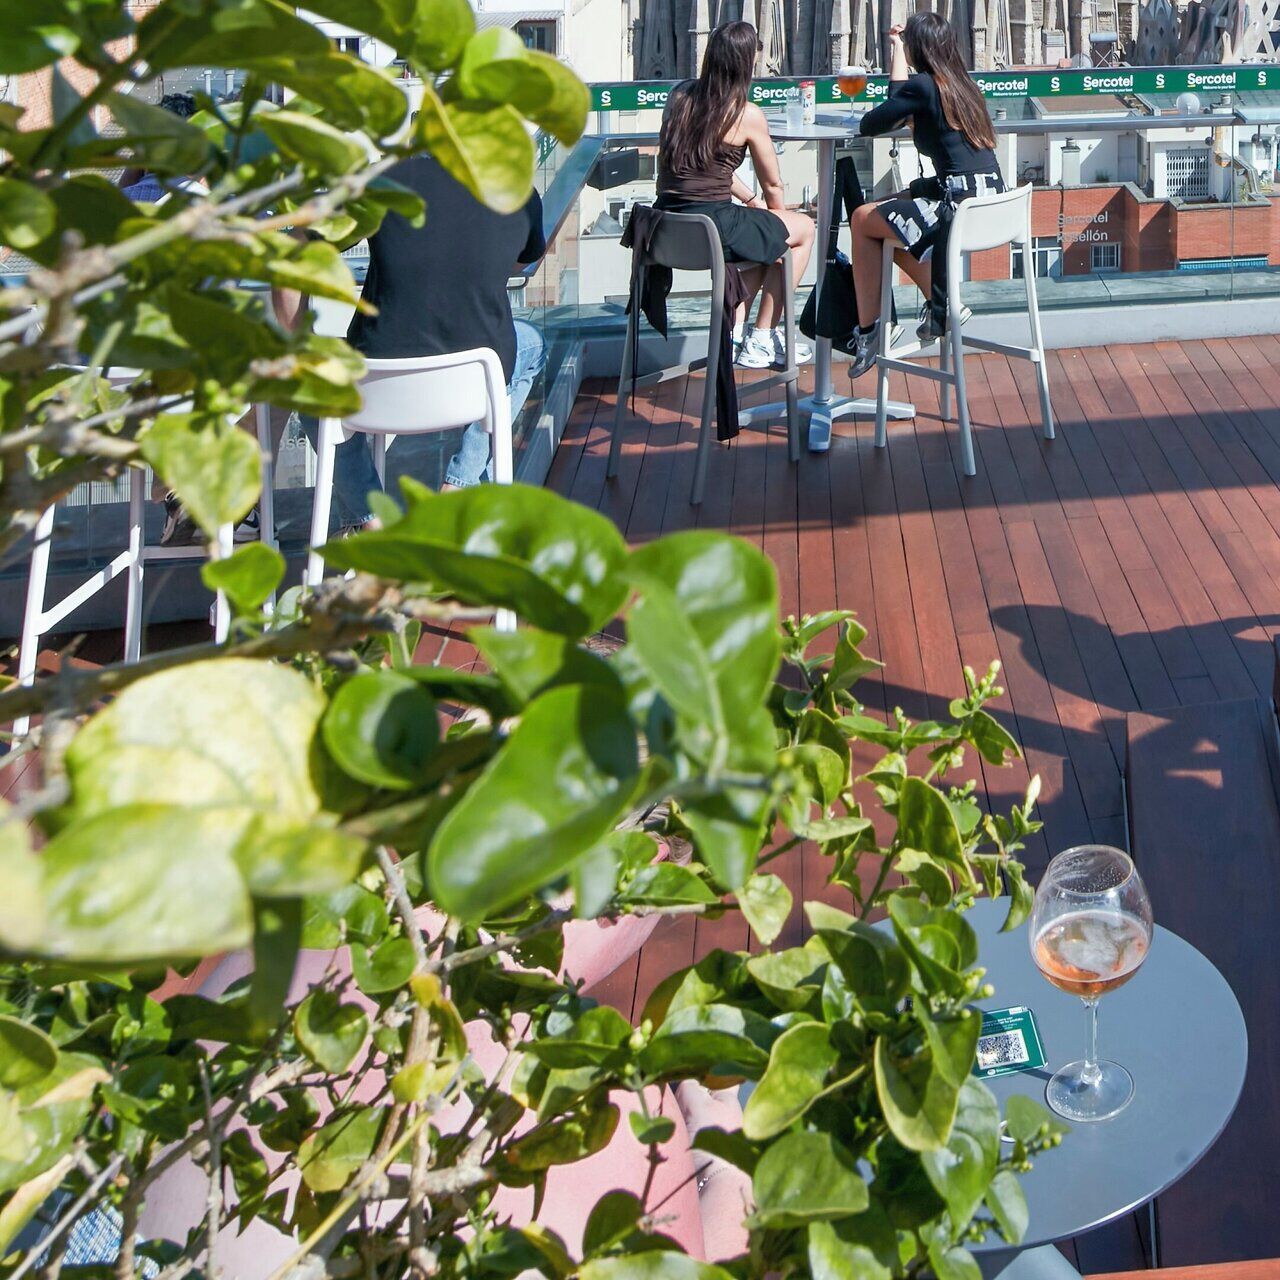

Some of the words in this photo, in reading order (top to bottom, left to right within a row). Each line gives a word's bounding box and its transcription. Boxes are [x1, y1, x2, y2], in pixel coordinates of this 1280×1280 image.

[1051, 77, 1059, 89] S
[1084, 75, 1133, 88] Sercotel
[1156, 74, 1164, 86] S
[1188, 72, 1235, 85] Sercotel
[1258, 71, 1266, 84] S
[977, 78, 1027, 91] Sercotel
[602, 91, 611, 103] S
[638, 90, 668, 102] Serc
[1057, 211, 1108, 226] Sercotel
